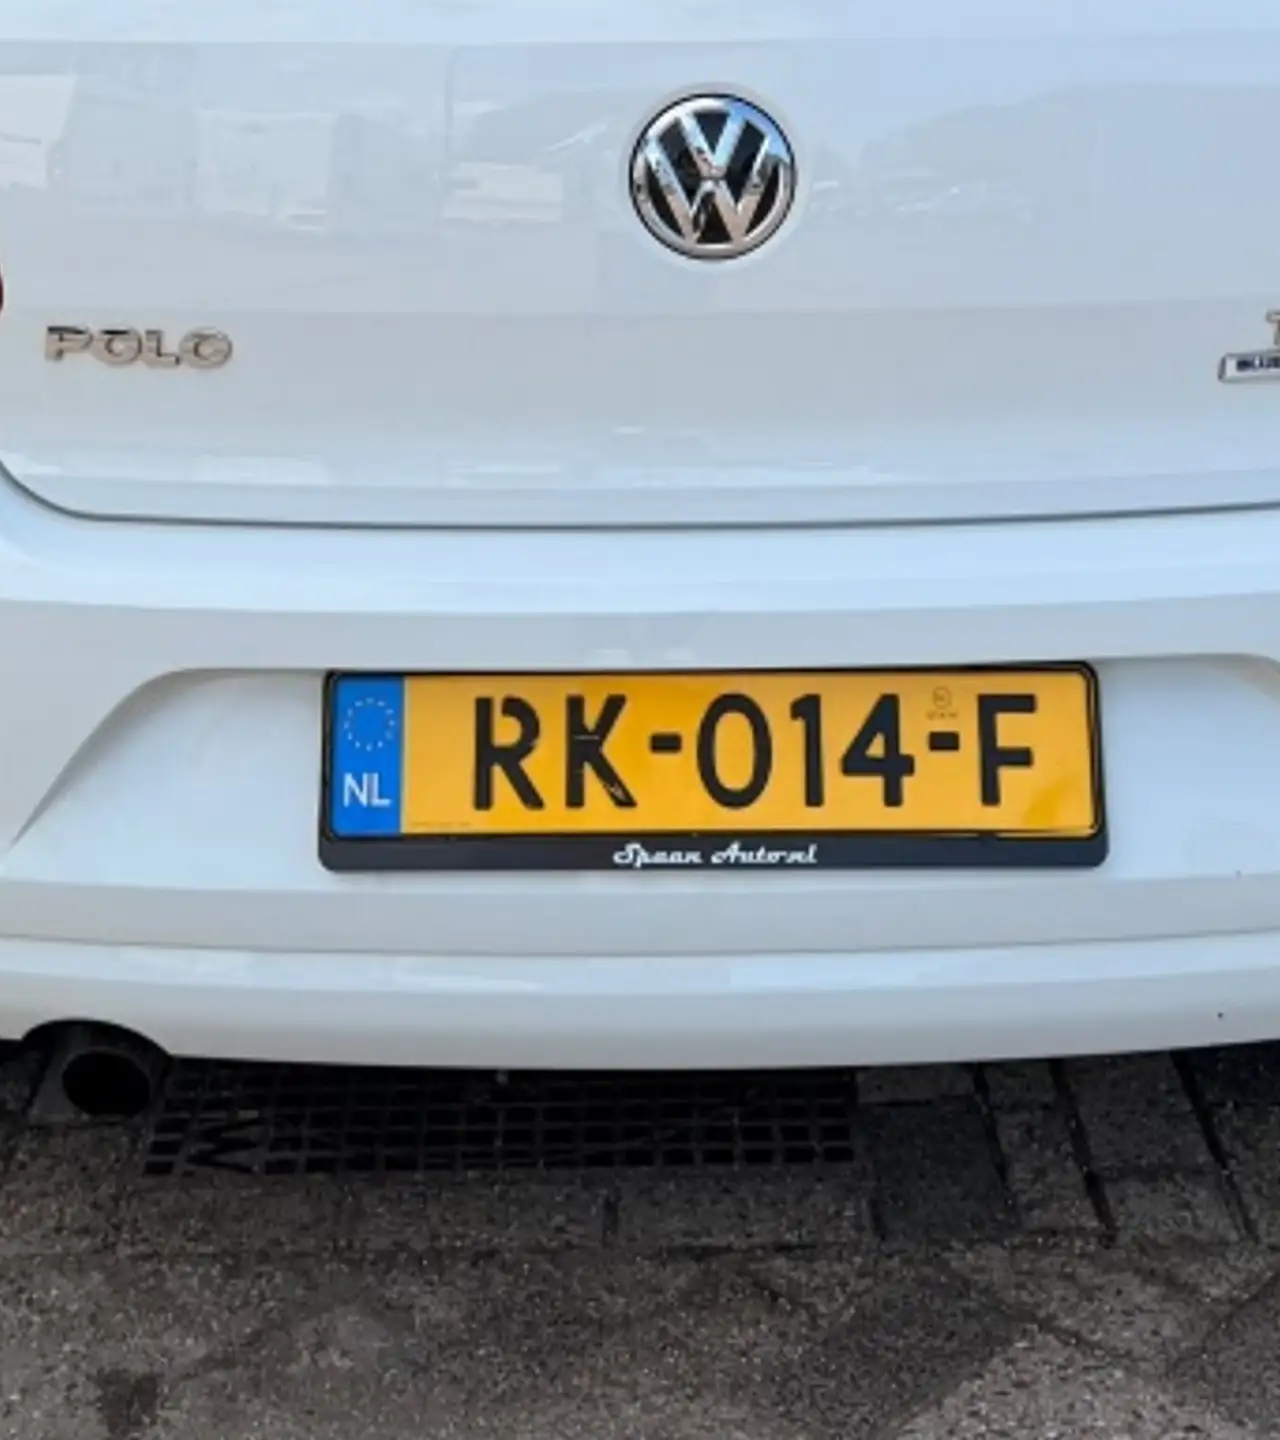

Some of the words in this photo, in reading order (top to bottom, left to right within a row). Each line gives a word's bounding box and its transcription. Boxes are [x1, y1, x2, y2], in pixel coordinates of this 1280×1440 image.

[45, 325, 233, 368] POLO
[472, 693, 1037, 810] RK-014-F
[342, 771, 393, 807] NL
[612, 841, 704, 869] Spaan
